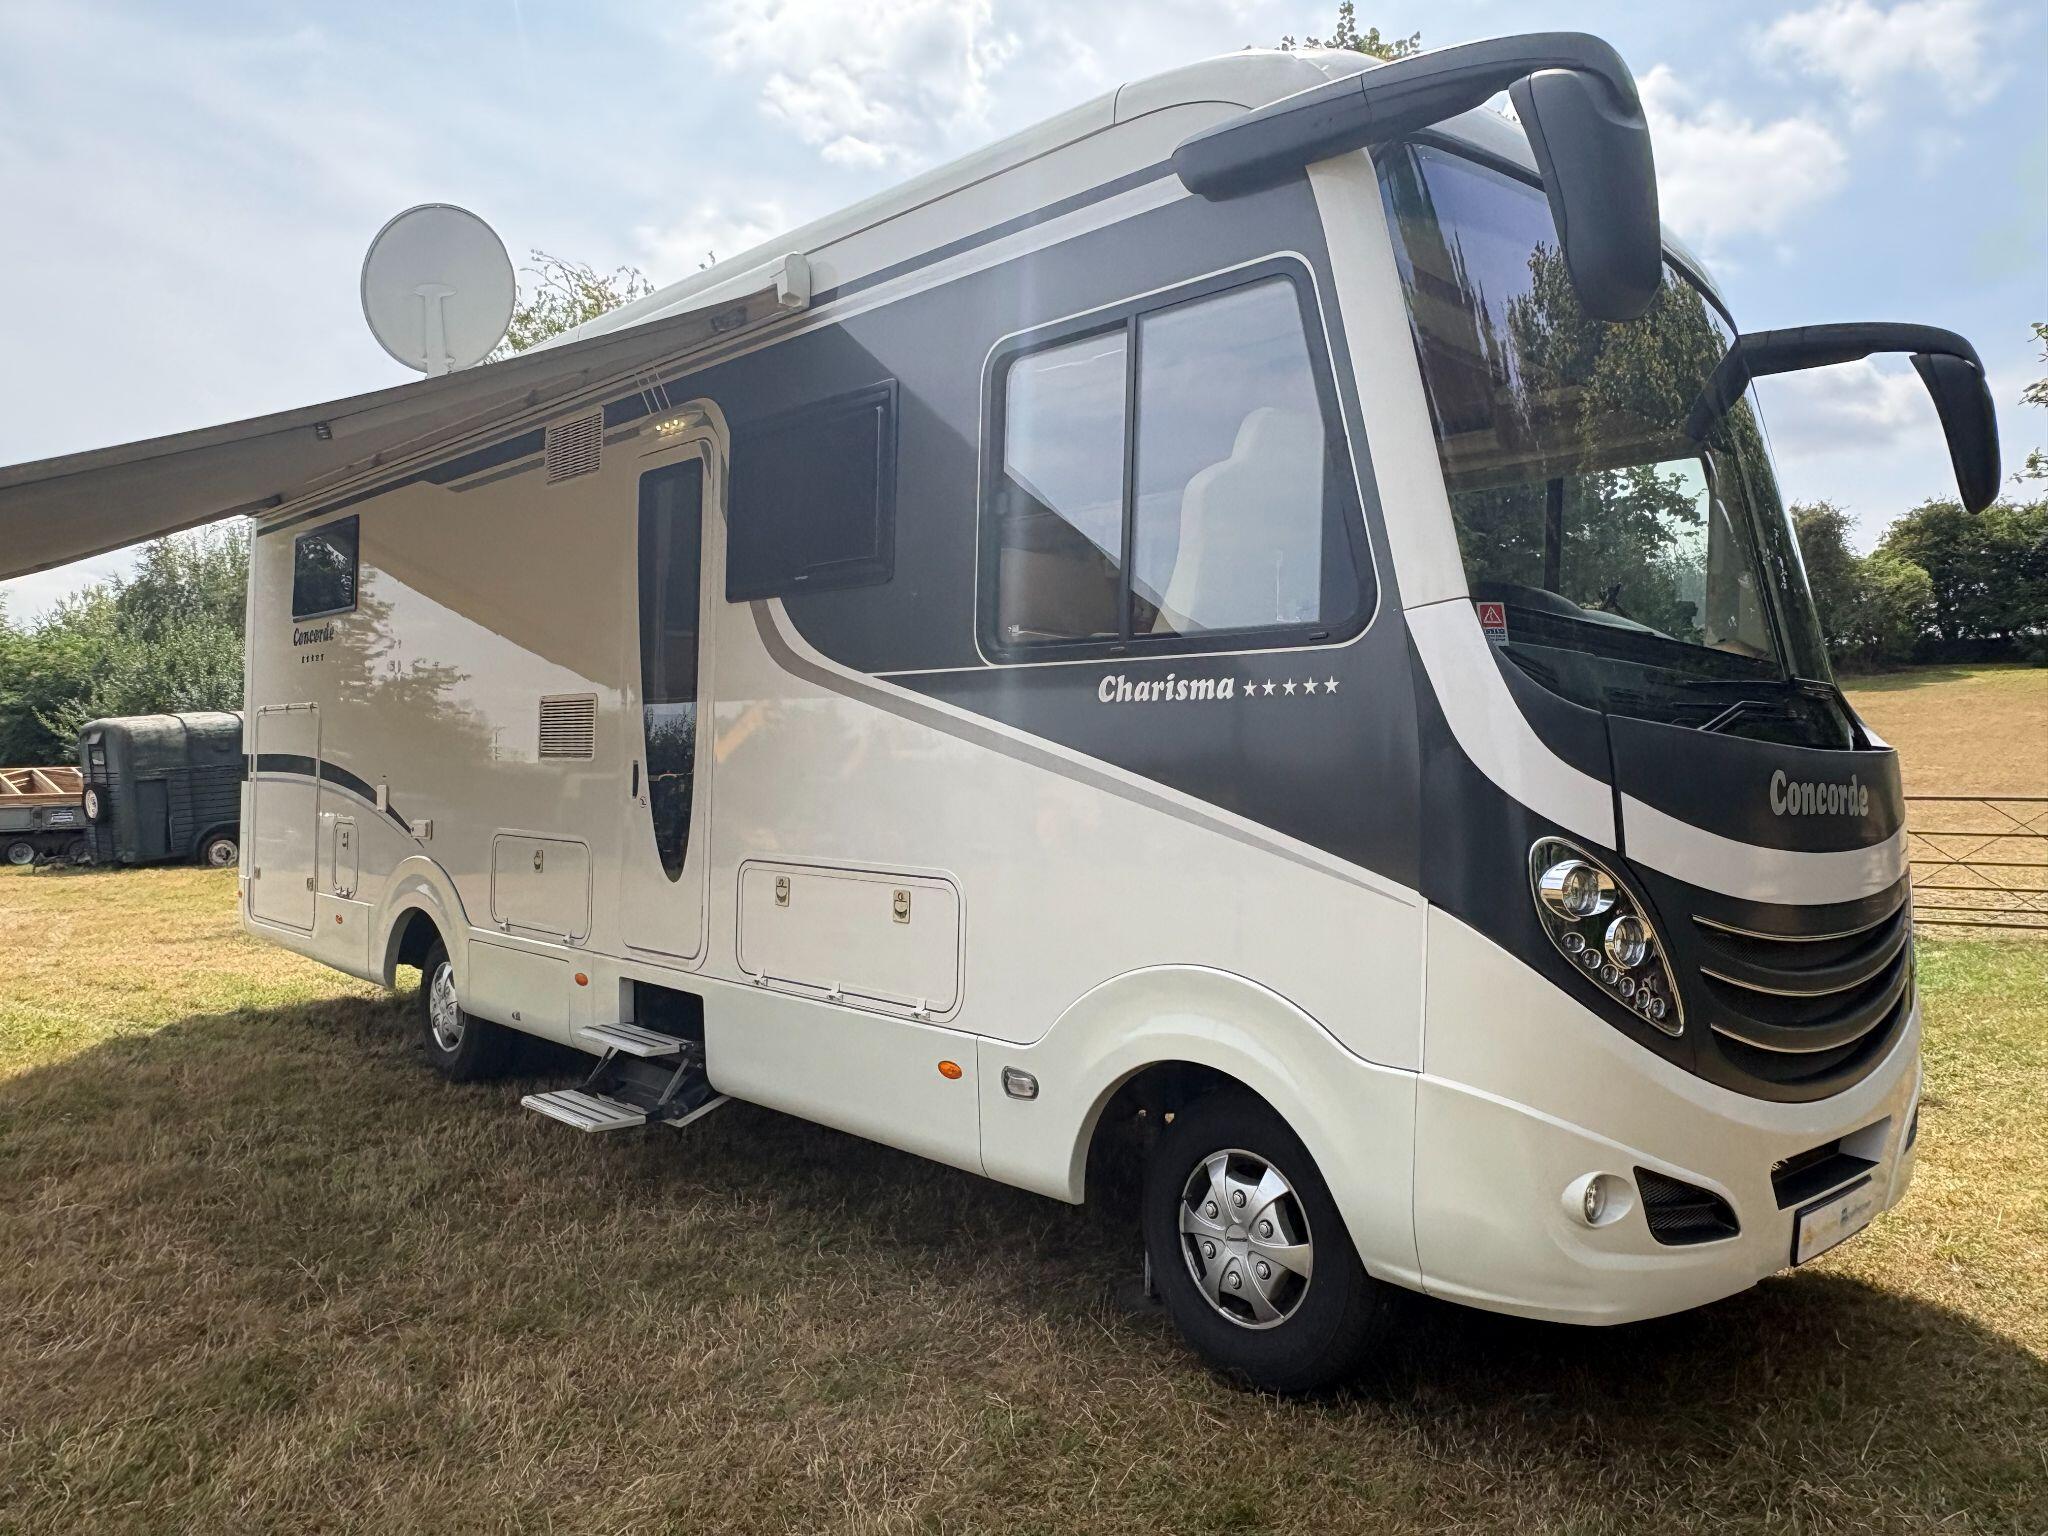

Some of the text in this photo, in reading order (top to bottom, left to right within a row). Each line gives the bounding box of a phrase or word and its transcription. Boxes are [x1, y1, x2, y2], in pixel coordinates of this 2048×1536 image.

[293, 622, 335, 646] Concorde
[1098, 673, 1235, 702] Charisma
[1769, 769, 1869, 816] Concorde
